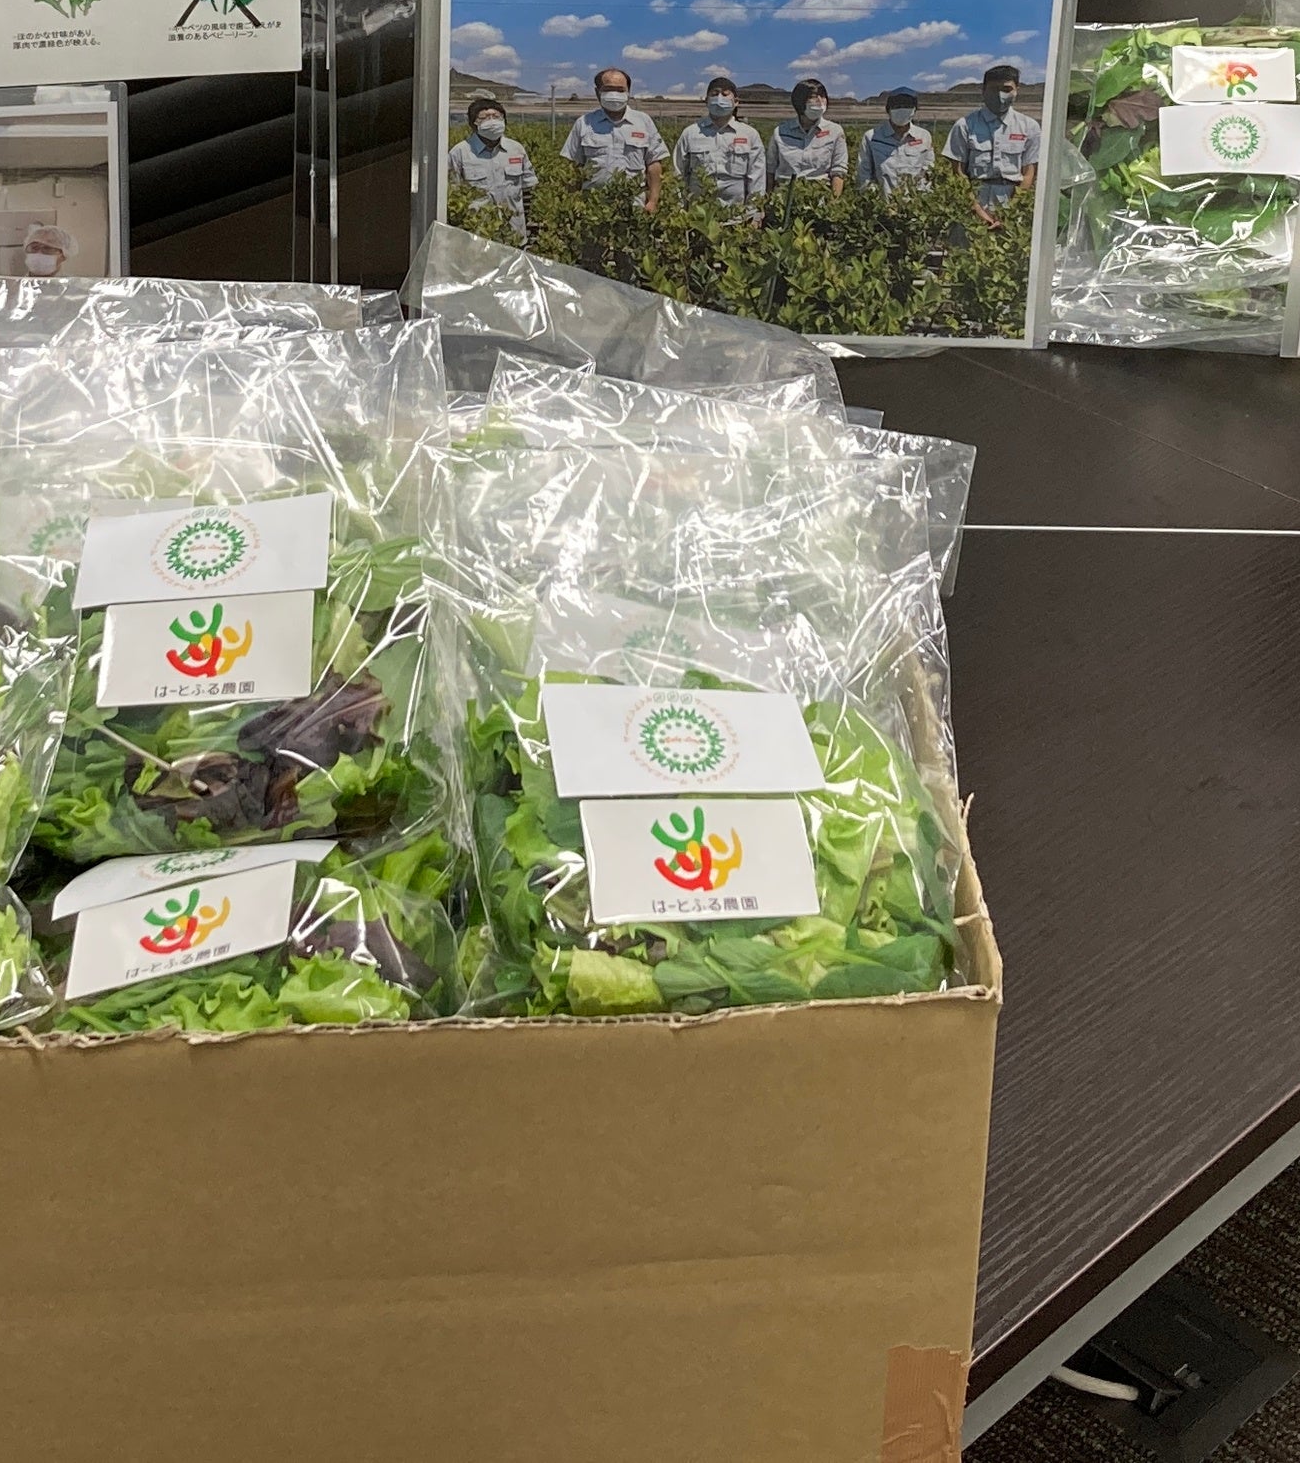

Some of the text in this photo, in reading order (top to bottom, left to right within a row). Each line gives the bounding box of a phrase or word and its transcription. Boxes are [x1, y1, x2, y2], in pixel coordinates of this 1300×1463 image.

[154, 681, 255, 697] はーとふる農園
[652, 896, 759, 915] はーとふる農園
